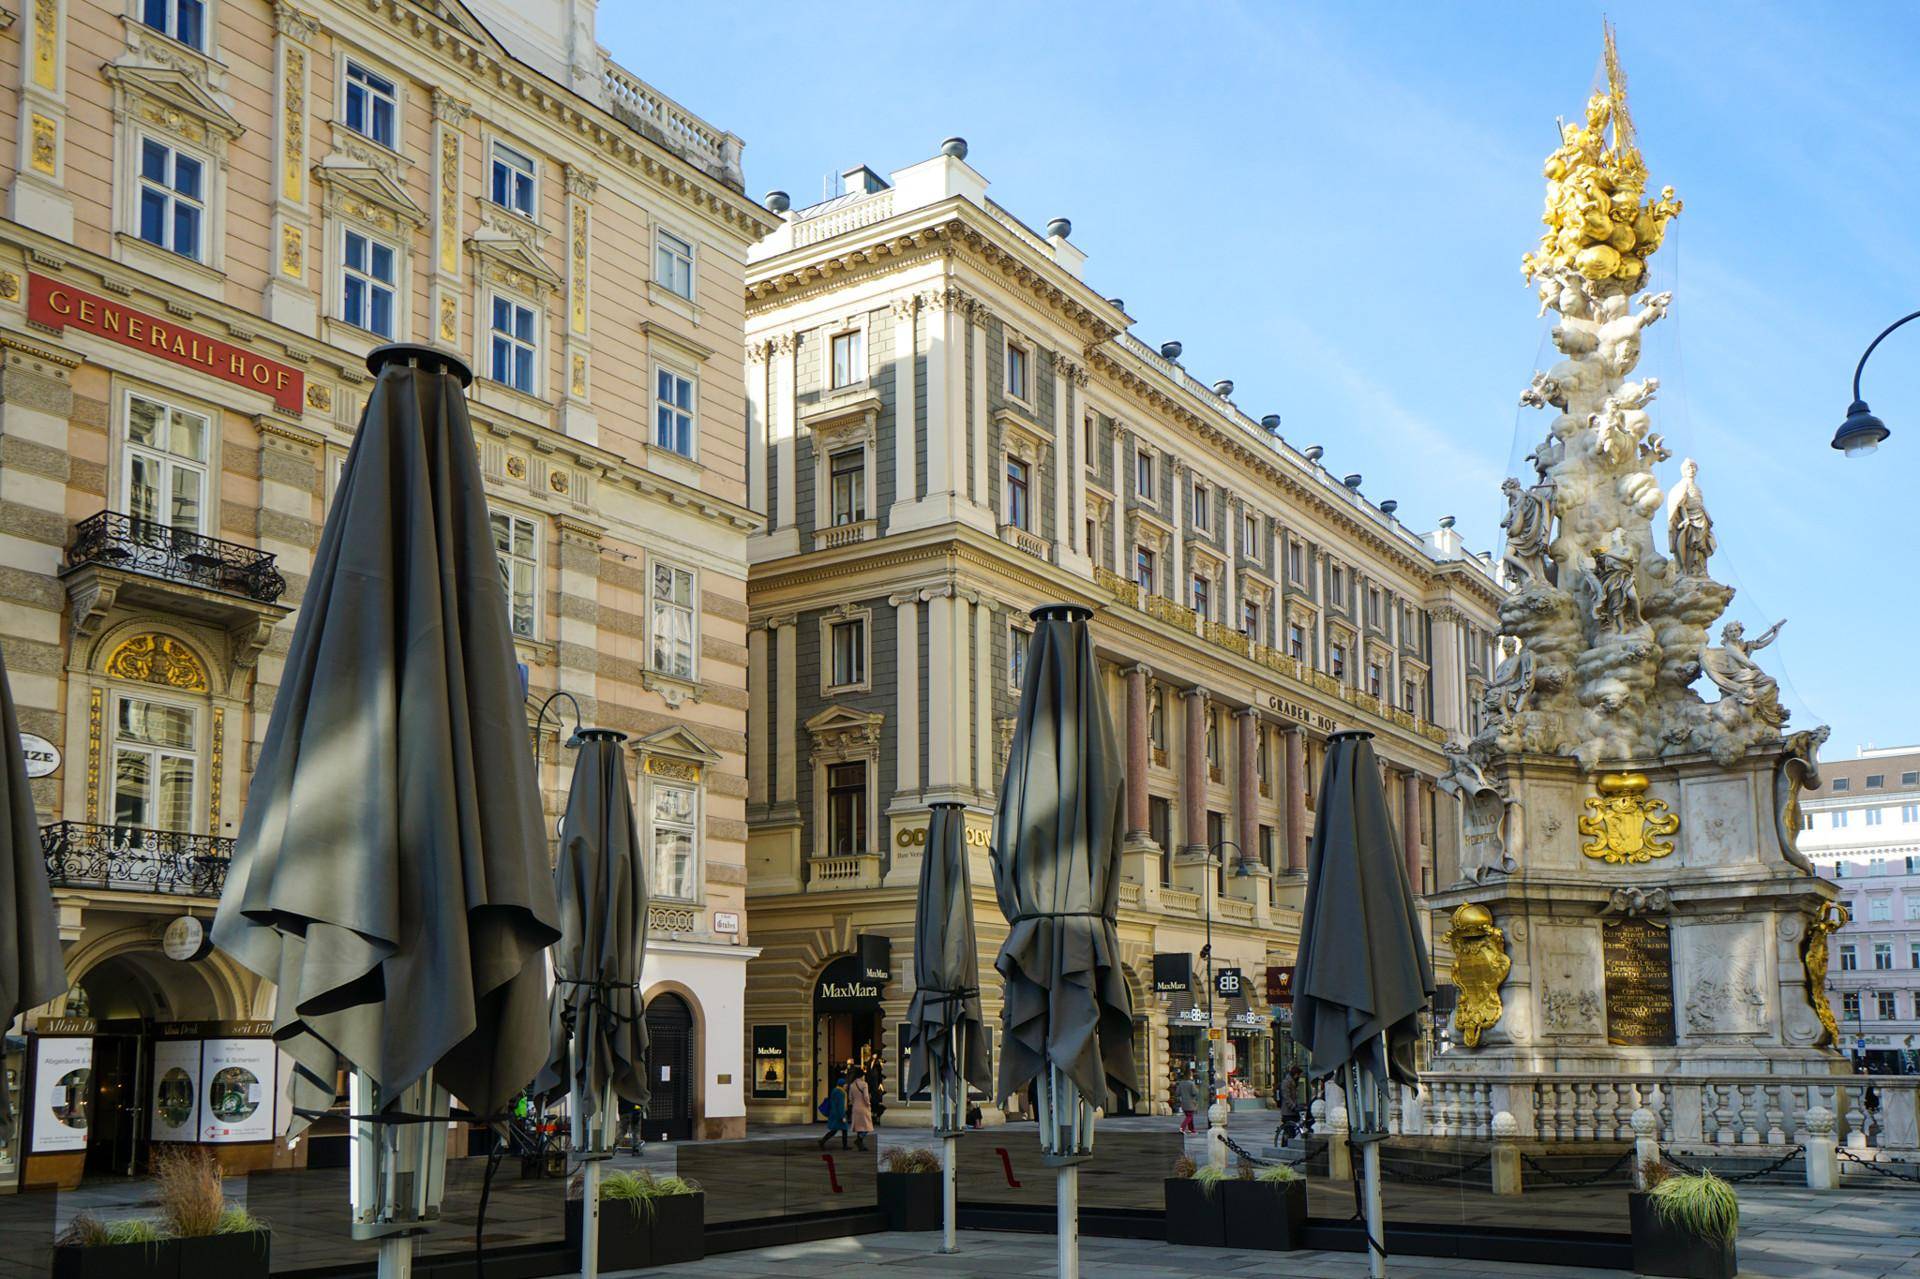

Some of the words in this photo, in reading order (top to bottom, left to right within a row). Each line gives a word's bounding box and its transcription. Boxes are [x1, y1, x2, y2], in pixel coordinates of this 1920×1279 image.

[866, 968, 888, 979] MaxMara
[821, 982, 877, 998] MaxMara
[1157, 981, 1186, 990] MaxMara
[46, 1019, 79, 1032] Albin
[232, 1023, 251, 1034] seit
[255, 1023, 273, 1034] 170
[757, 1047, 782, 1055] MaxMara
